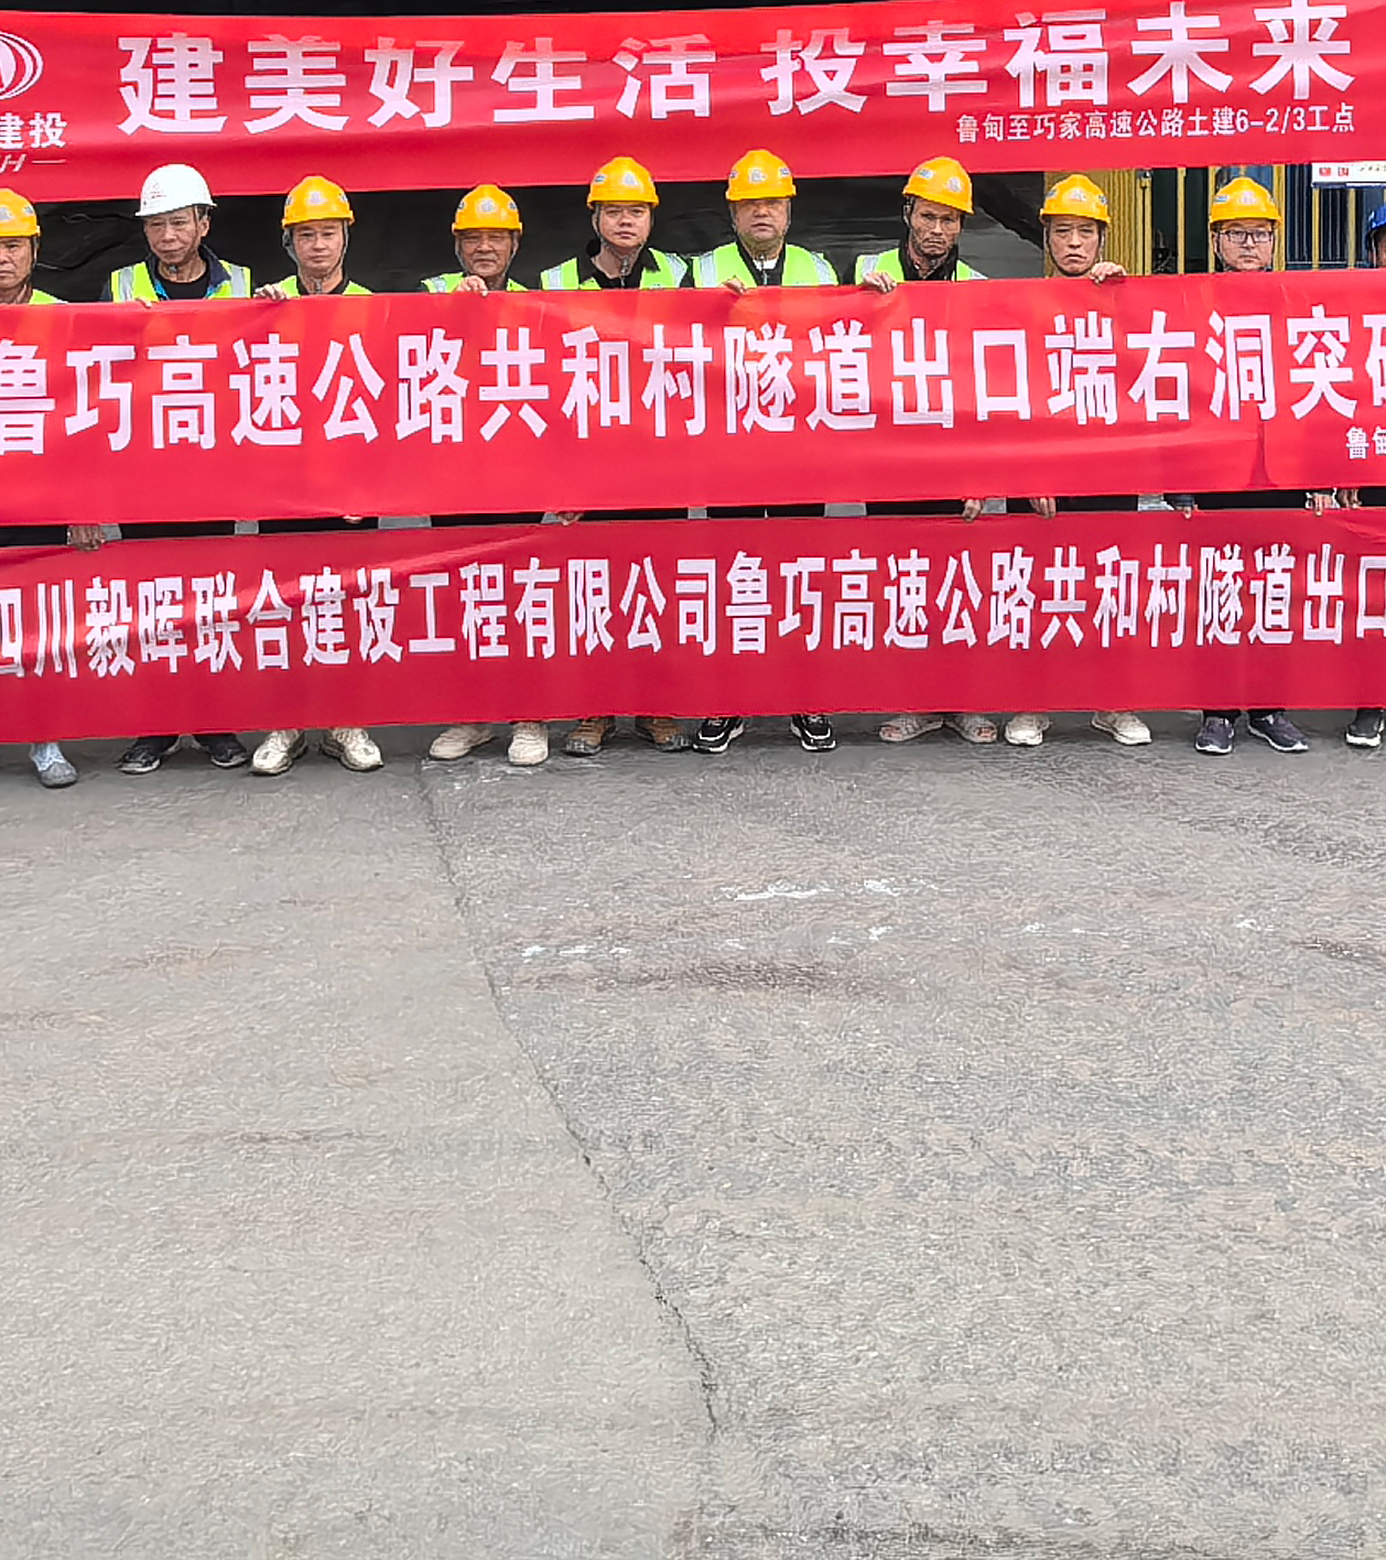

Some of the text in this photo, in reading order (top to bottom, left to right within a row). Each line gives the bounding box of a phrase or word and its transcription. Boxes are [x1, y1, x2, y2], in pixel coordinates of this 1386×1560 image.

[955, 102, 1356, 143] 鲁甸至巧家高速公路土建6-2/3工点
